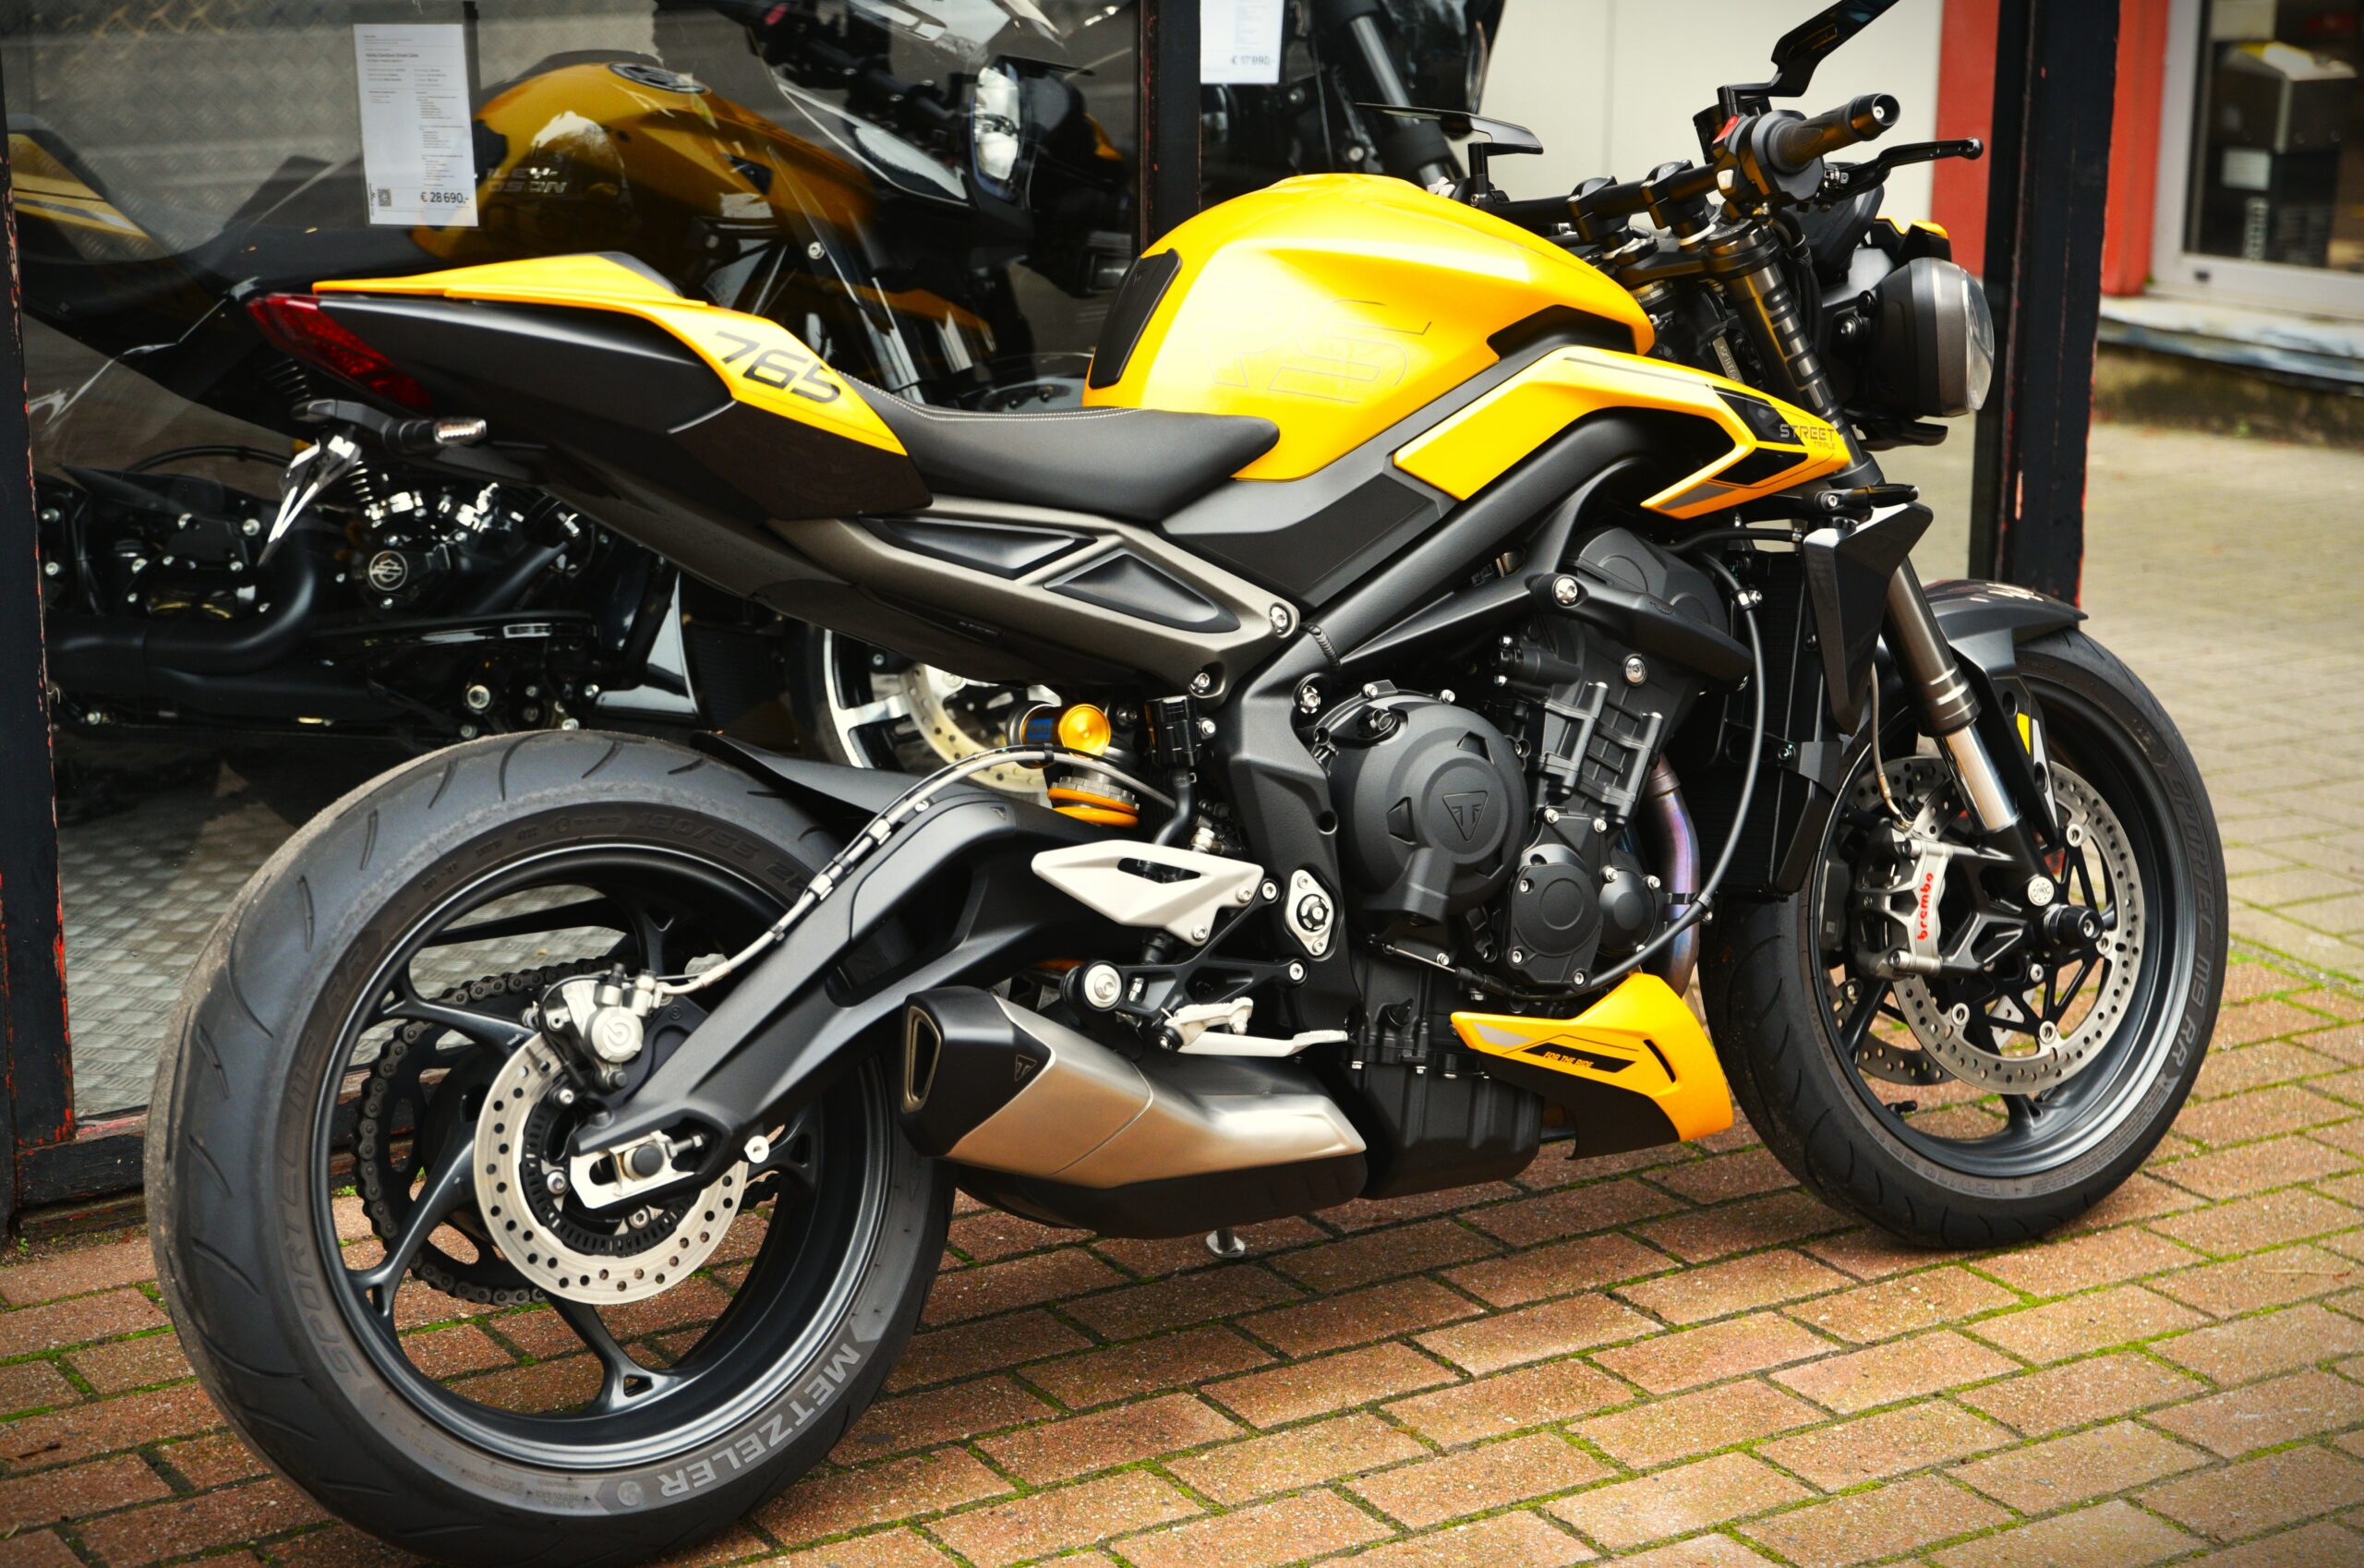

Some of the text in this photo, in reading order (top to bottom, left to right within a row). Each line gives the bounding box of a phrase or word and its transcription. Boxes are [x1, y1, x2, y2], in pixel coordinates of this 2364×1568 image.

[714, 330, 841, 404] 765
[1779, 423, 1835, 442] STREET
[1916, 872, 1934, 940] brembo
[2171, 1013, 2197, 1068] RR
[657, 1342, 861, 1498] METZELER
